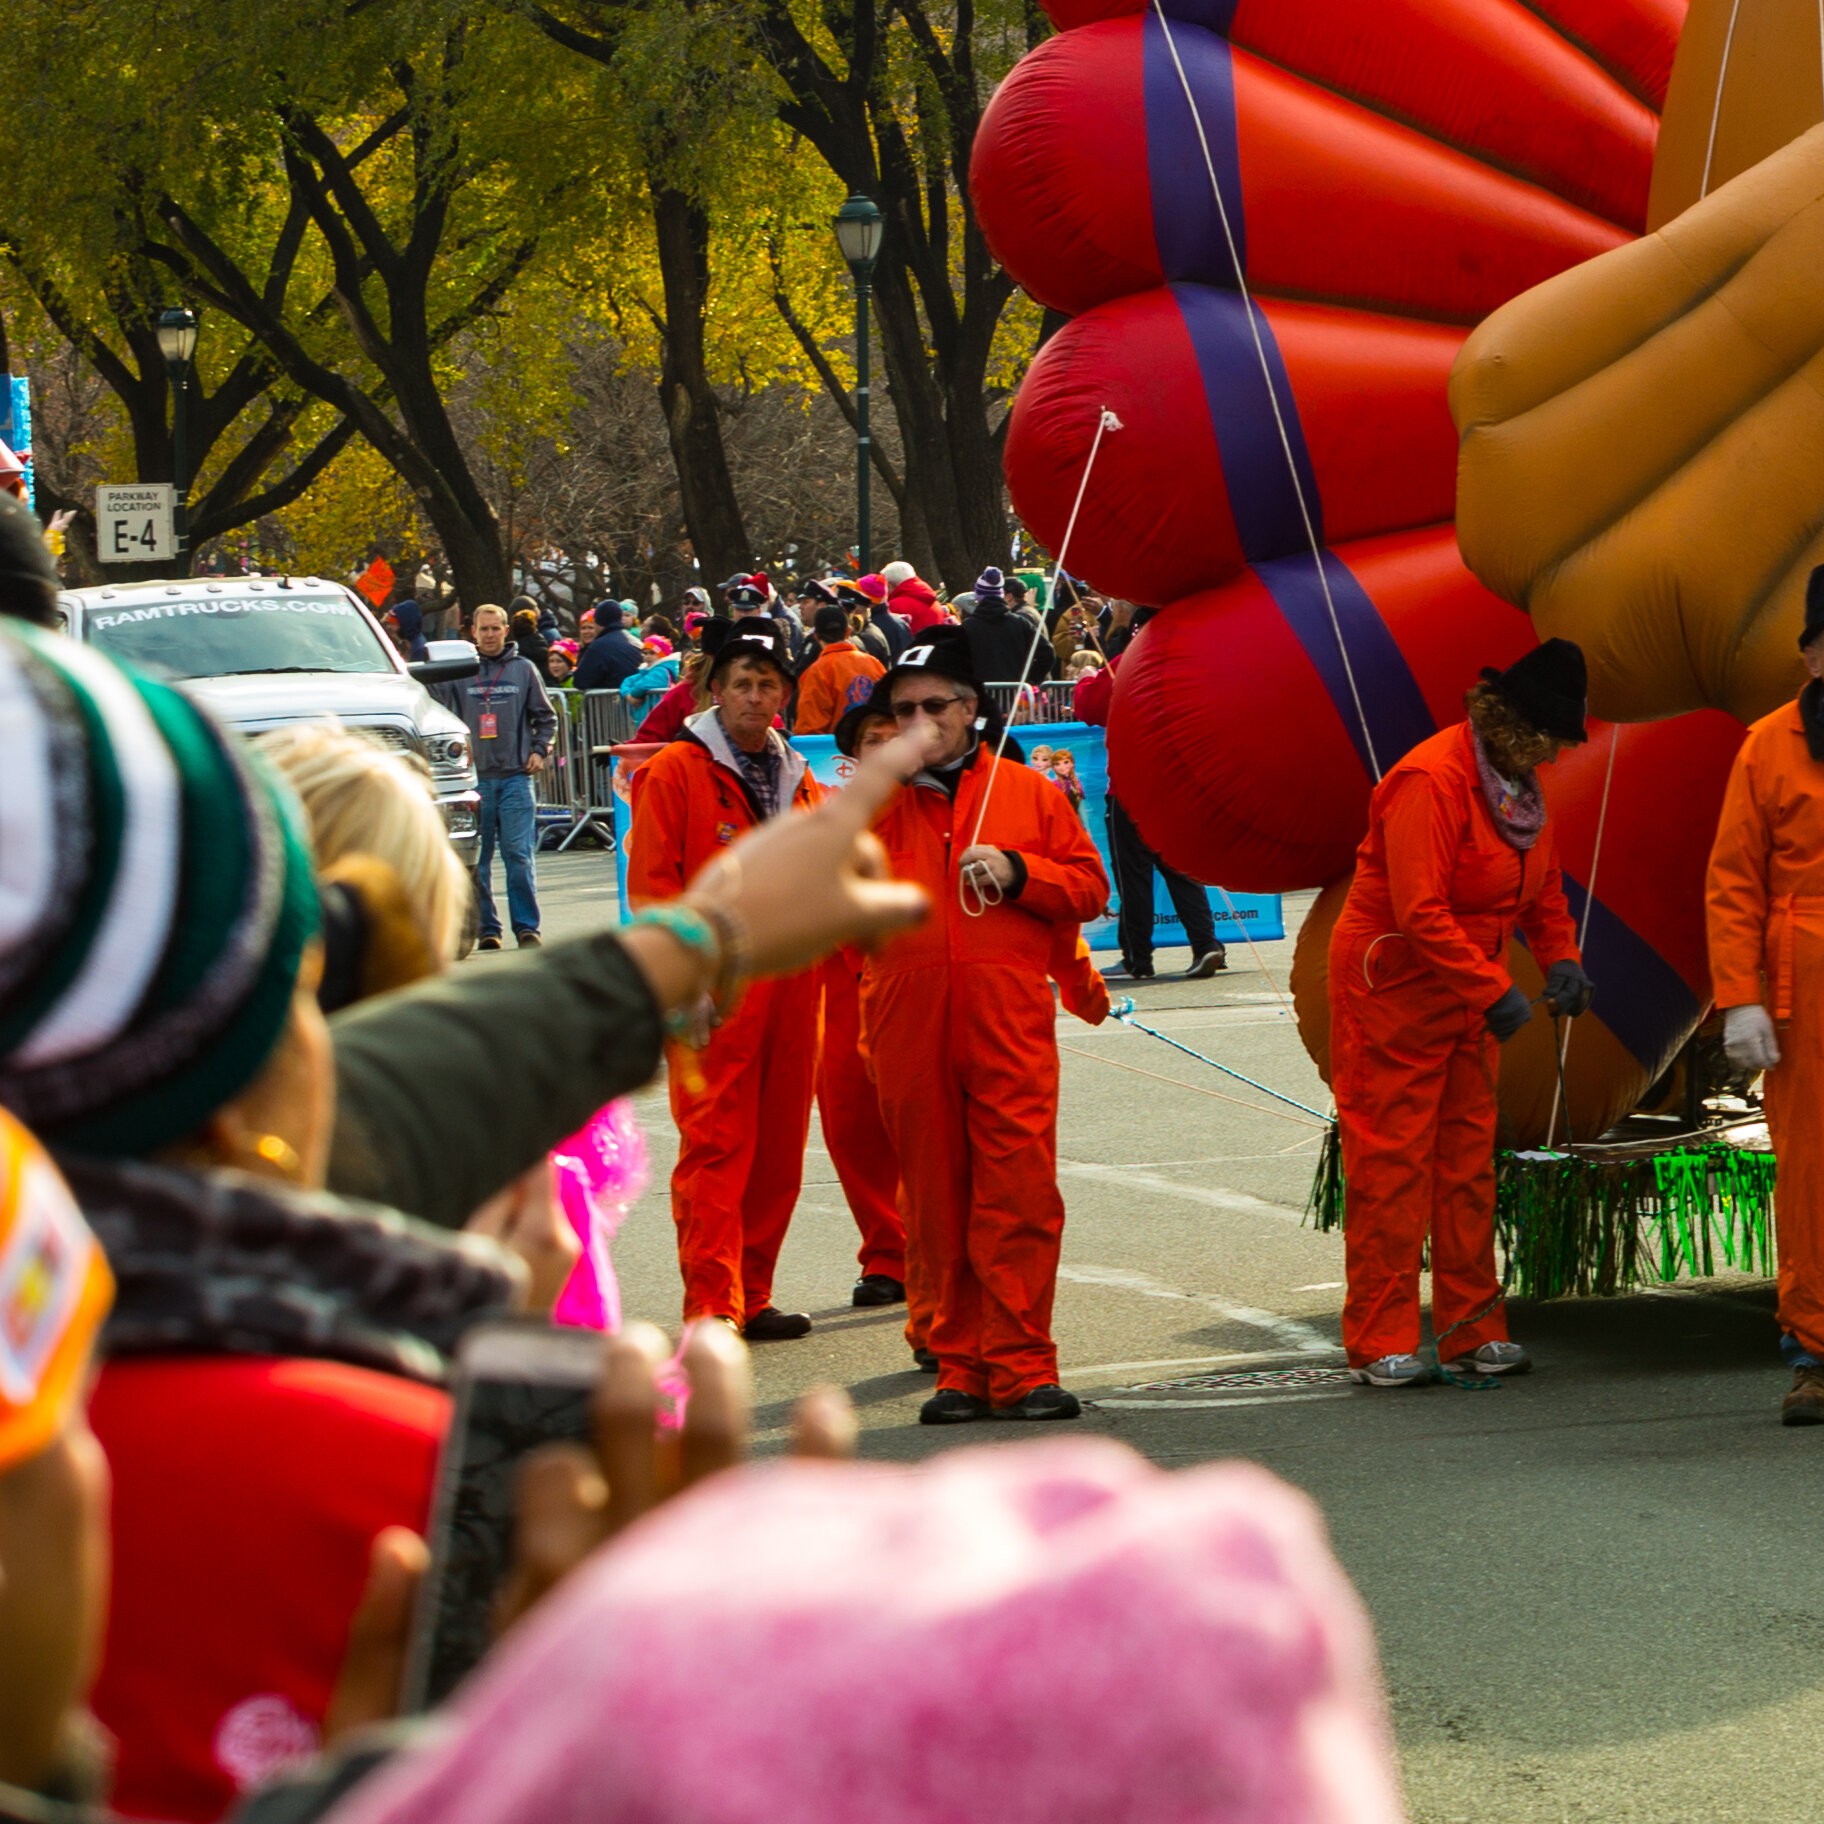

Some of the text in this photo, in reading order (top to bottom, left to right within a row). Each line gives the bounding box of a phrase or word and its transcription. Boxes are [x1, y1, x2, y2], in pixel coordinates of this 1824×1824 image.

[108, 491, 159, 501] PARKWAY
[107, 502, 161, 512] LOCATION
[114, 519, 157, 553] E-4
[94, 600, 354, 630] RAMTRUCKS.COM
